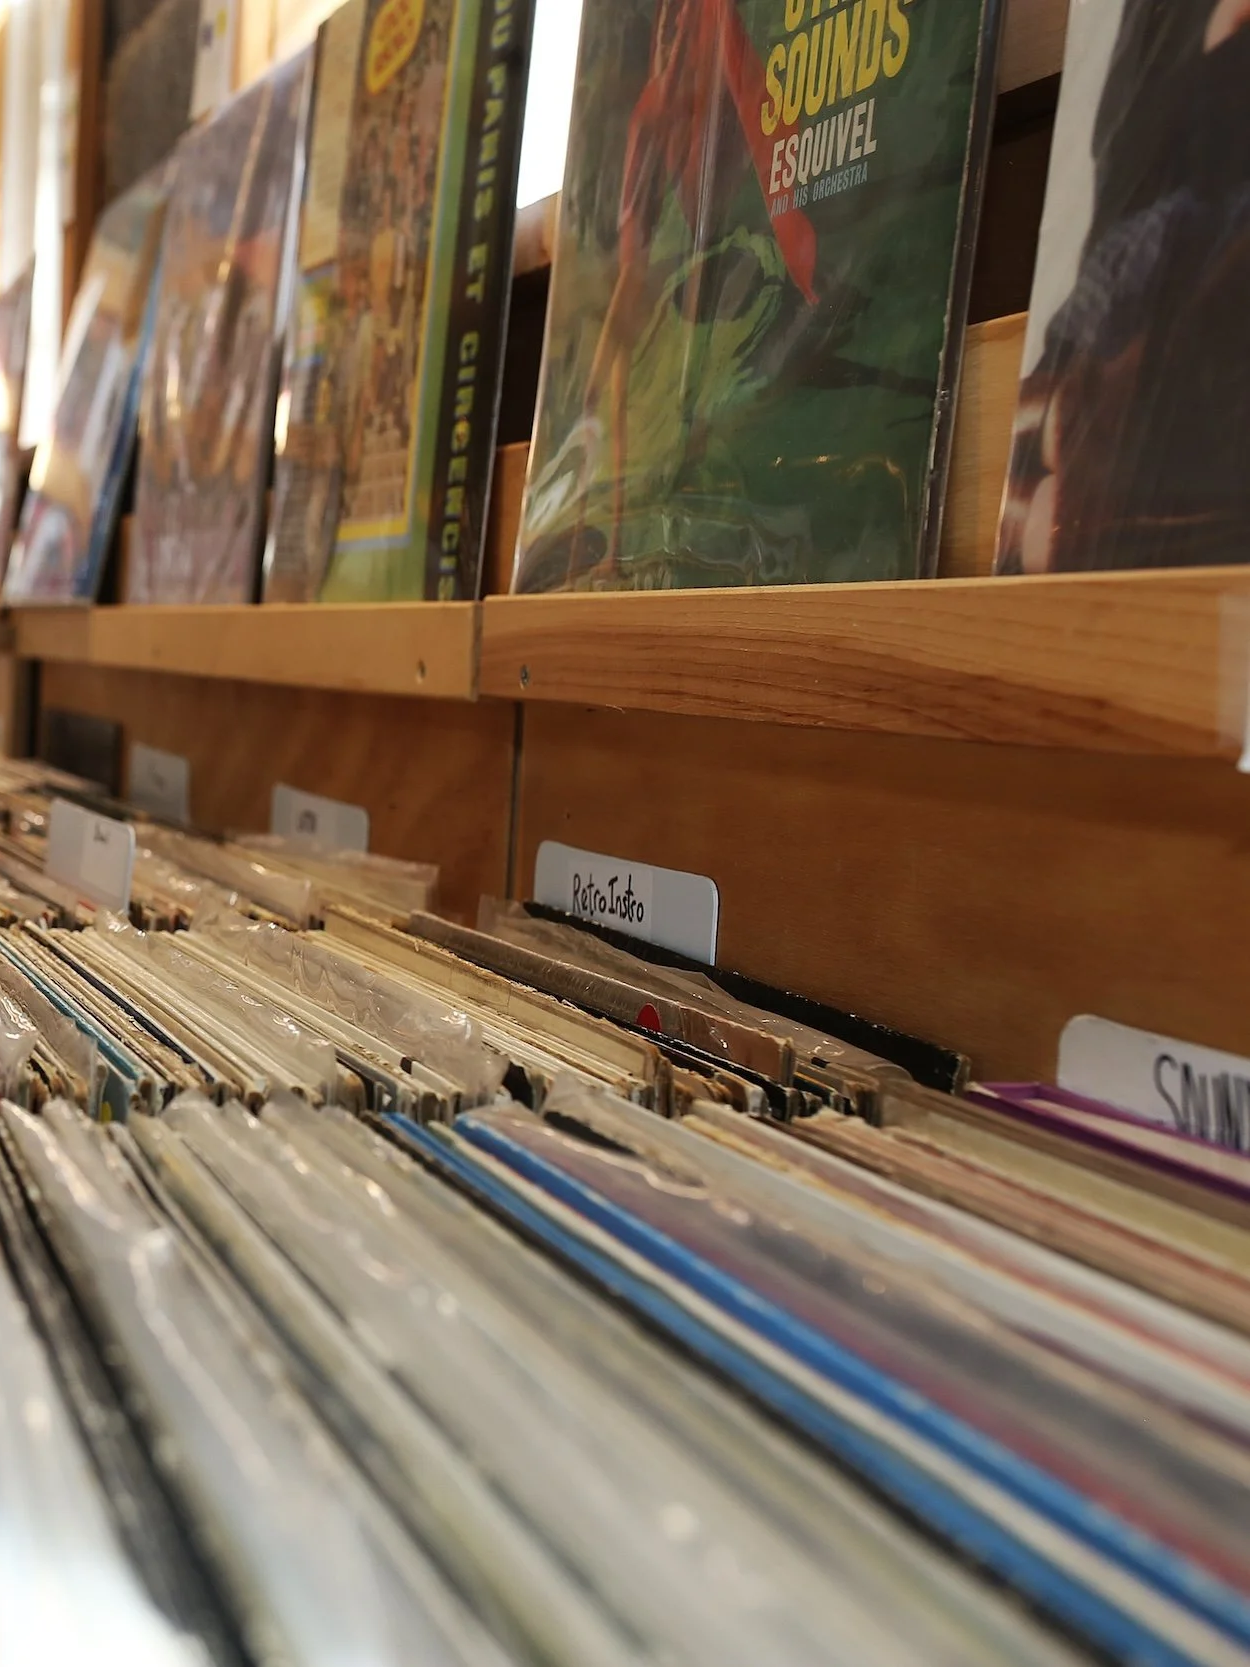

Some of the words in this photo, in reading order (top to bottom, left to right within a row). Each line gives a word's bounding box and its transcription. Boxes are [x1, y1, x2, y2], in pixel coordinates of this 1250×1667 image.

[761, 0, 910, 136] SOUNDS
[472, 62, 507, 221] PANIS
[769, 98, 877, 195] ESQUIVEL
[770, 193, 789, 218] AND
[793, 185, 808, 209] HIS
[812, 161, 868, 202] ORCHESTRA
[465, 242, 488, 303] ET
